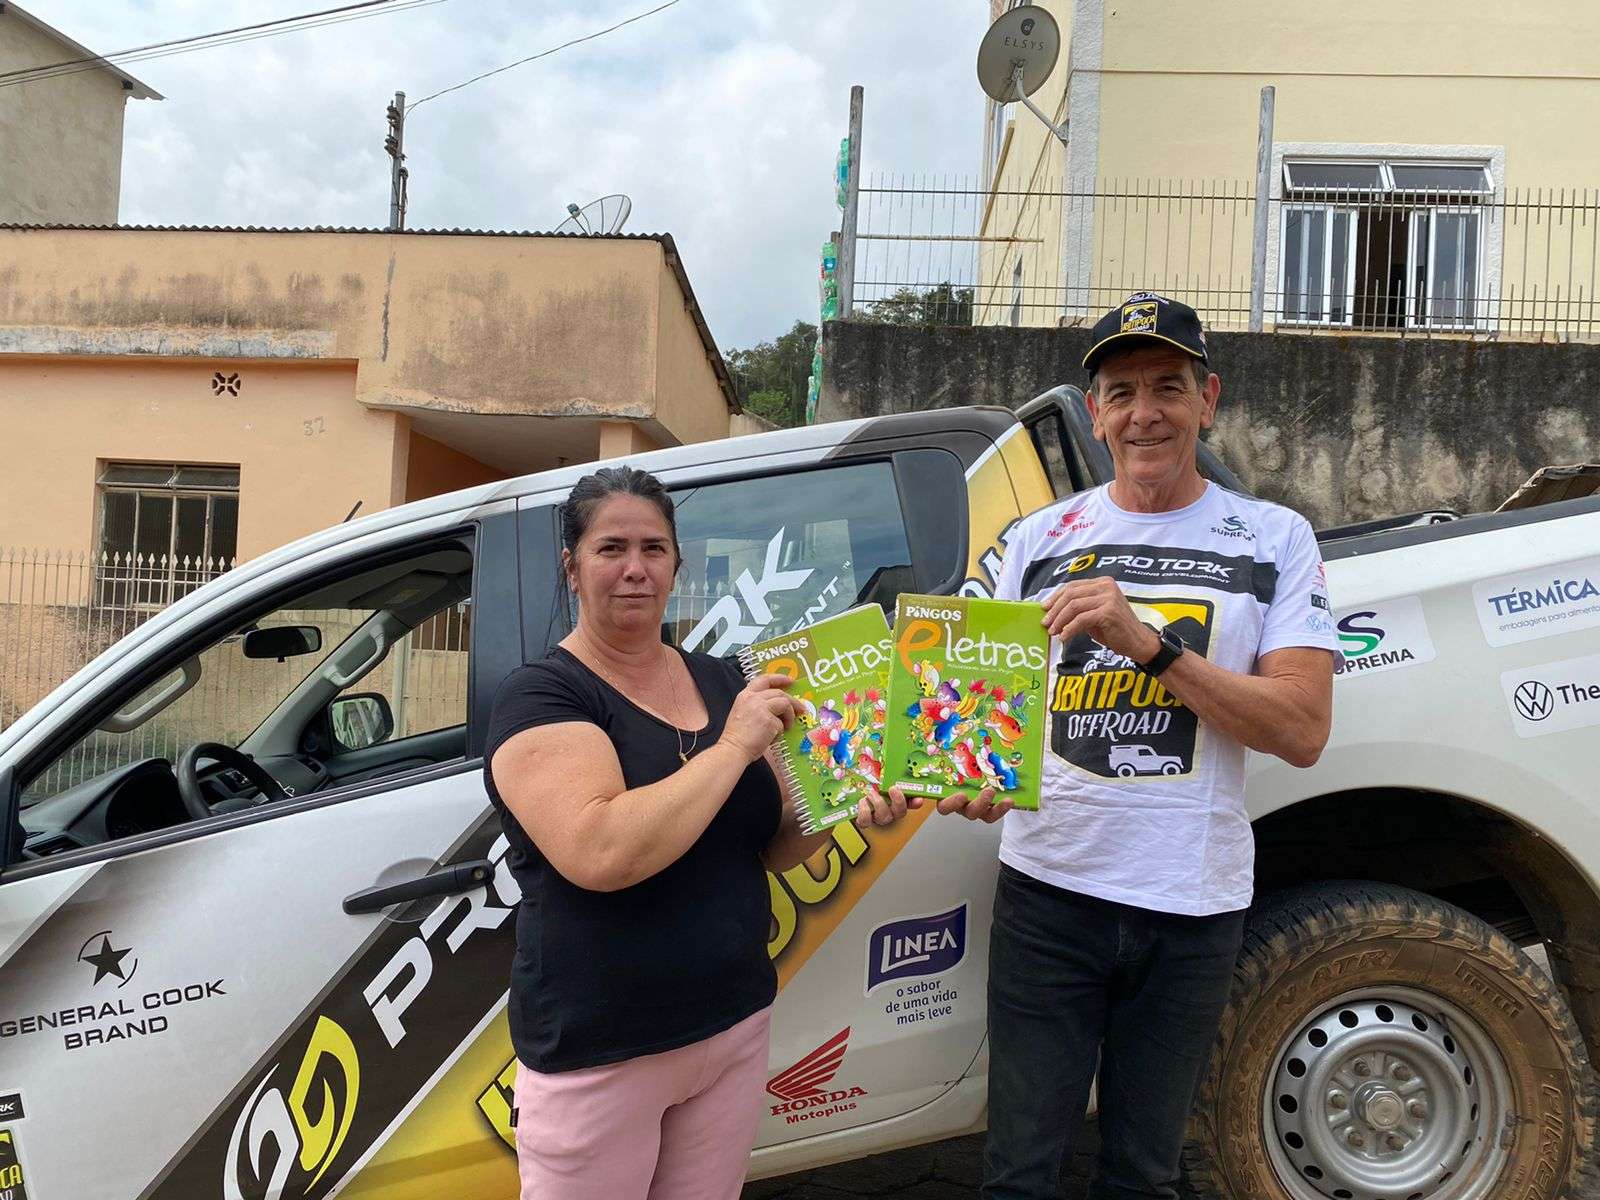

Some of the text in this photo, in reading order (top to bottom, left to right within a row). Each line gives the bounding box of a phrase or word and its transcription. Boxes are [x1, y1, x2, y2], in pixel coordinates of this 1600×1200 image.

[1004, 36, 1044, 50] ELSYS
[1096, 555, 1235, 579] PRO TORK
[1123, 568, 1160, 577] RACING
[1547, 608, 1568, 623] para
[944, 622, 1046, 671] letras
[796, 638, 894, 688] letras
[1334, 648, 1416, 675] PREMA
[1051, 669, 1183, 712] IBITIPOC
[1067, 710, 1172, 742] OFFROAD
[880, 930, 957, 974] LINEA
[885, 989, 958, 1014] de uma vida
[896, 980, 942, 998] o sabor
[0, 979, 227, 1037] GENERAL COOK
[896, 1005, 953, 1025] mais leve
[64, 1015, 168, 1050] BRAND
[770, 1086, 868, 1116] HONDA
[785, 1102, 857, 1124] Motoplus
